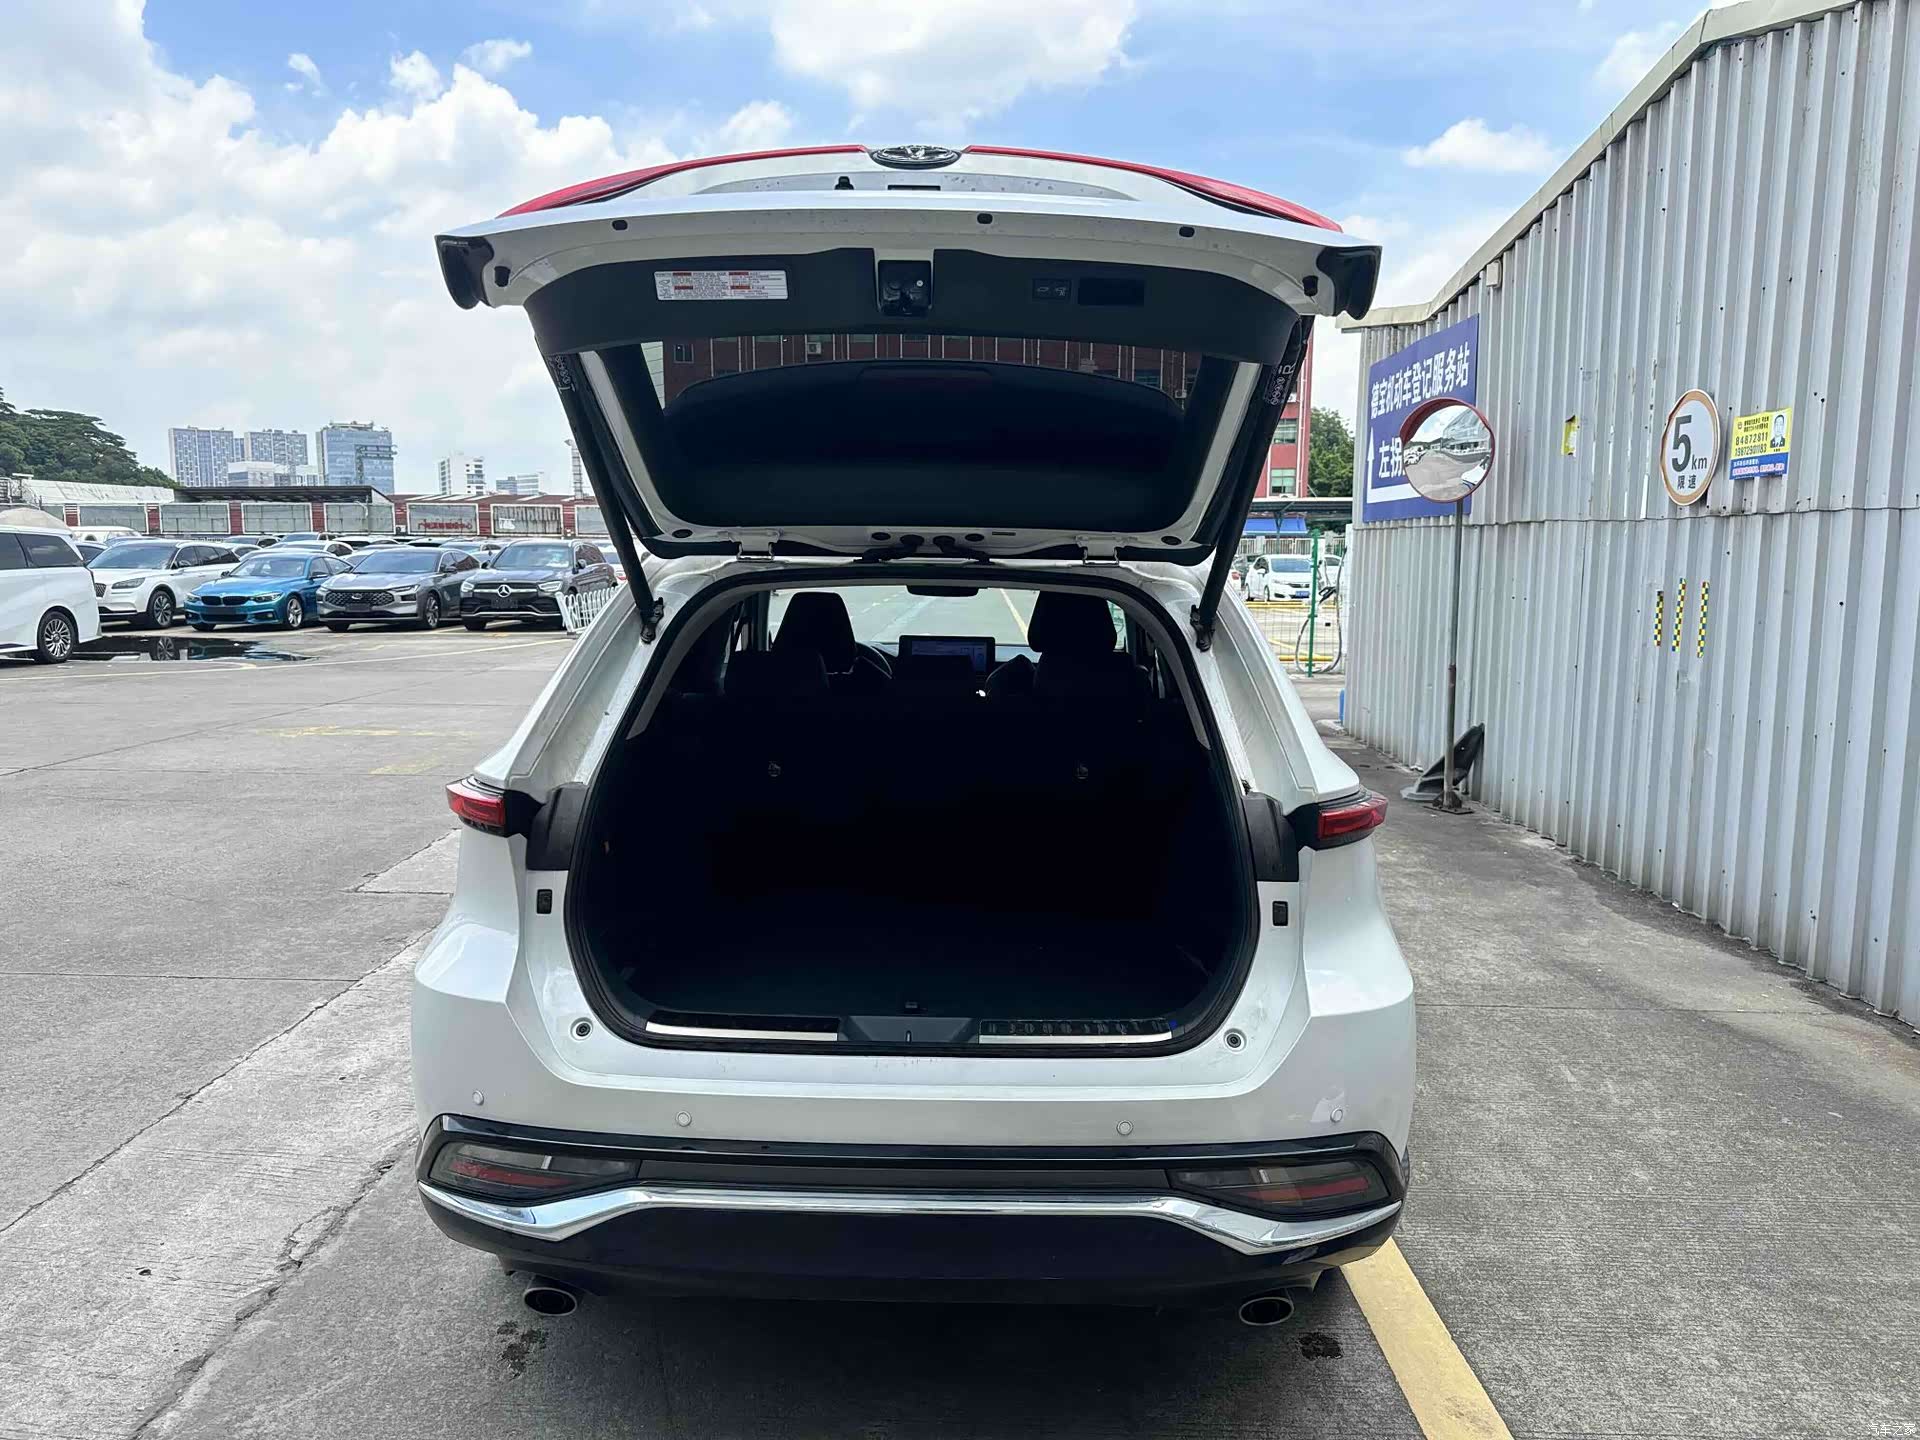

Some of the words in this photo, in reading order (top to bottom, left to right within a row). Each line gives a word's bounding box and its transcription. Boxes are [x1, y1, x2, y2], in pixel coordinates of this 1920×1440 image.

[1371, 341, 1470, 419] 德宝机动车登记服务站
[1379, 437, 1405, 478] 左拐
